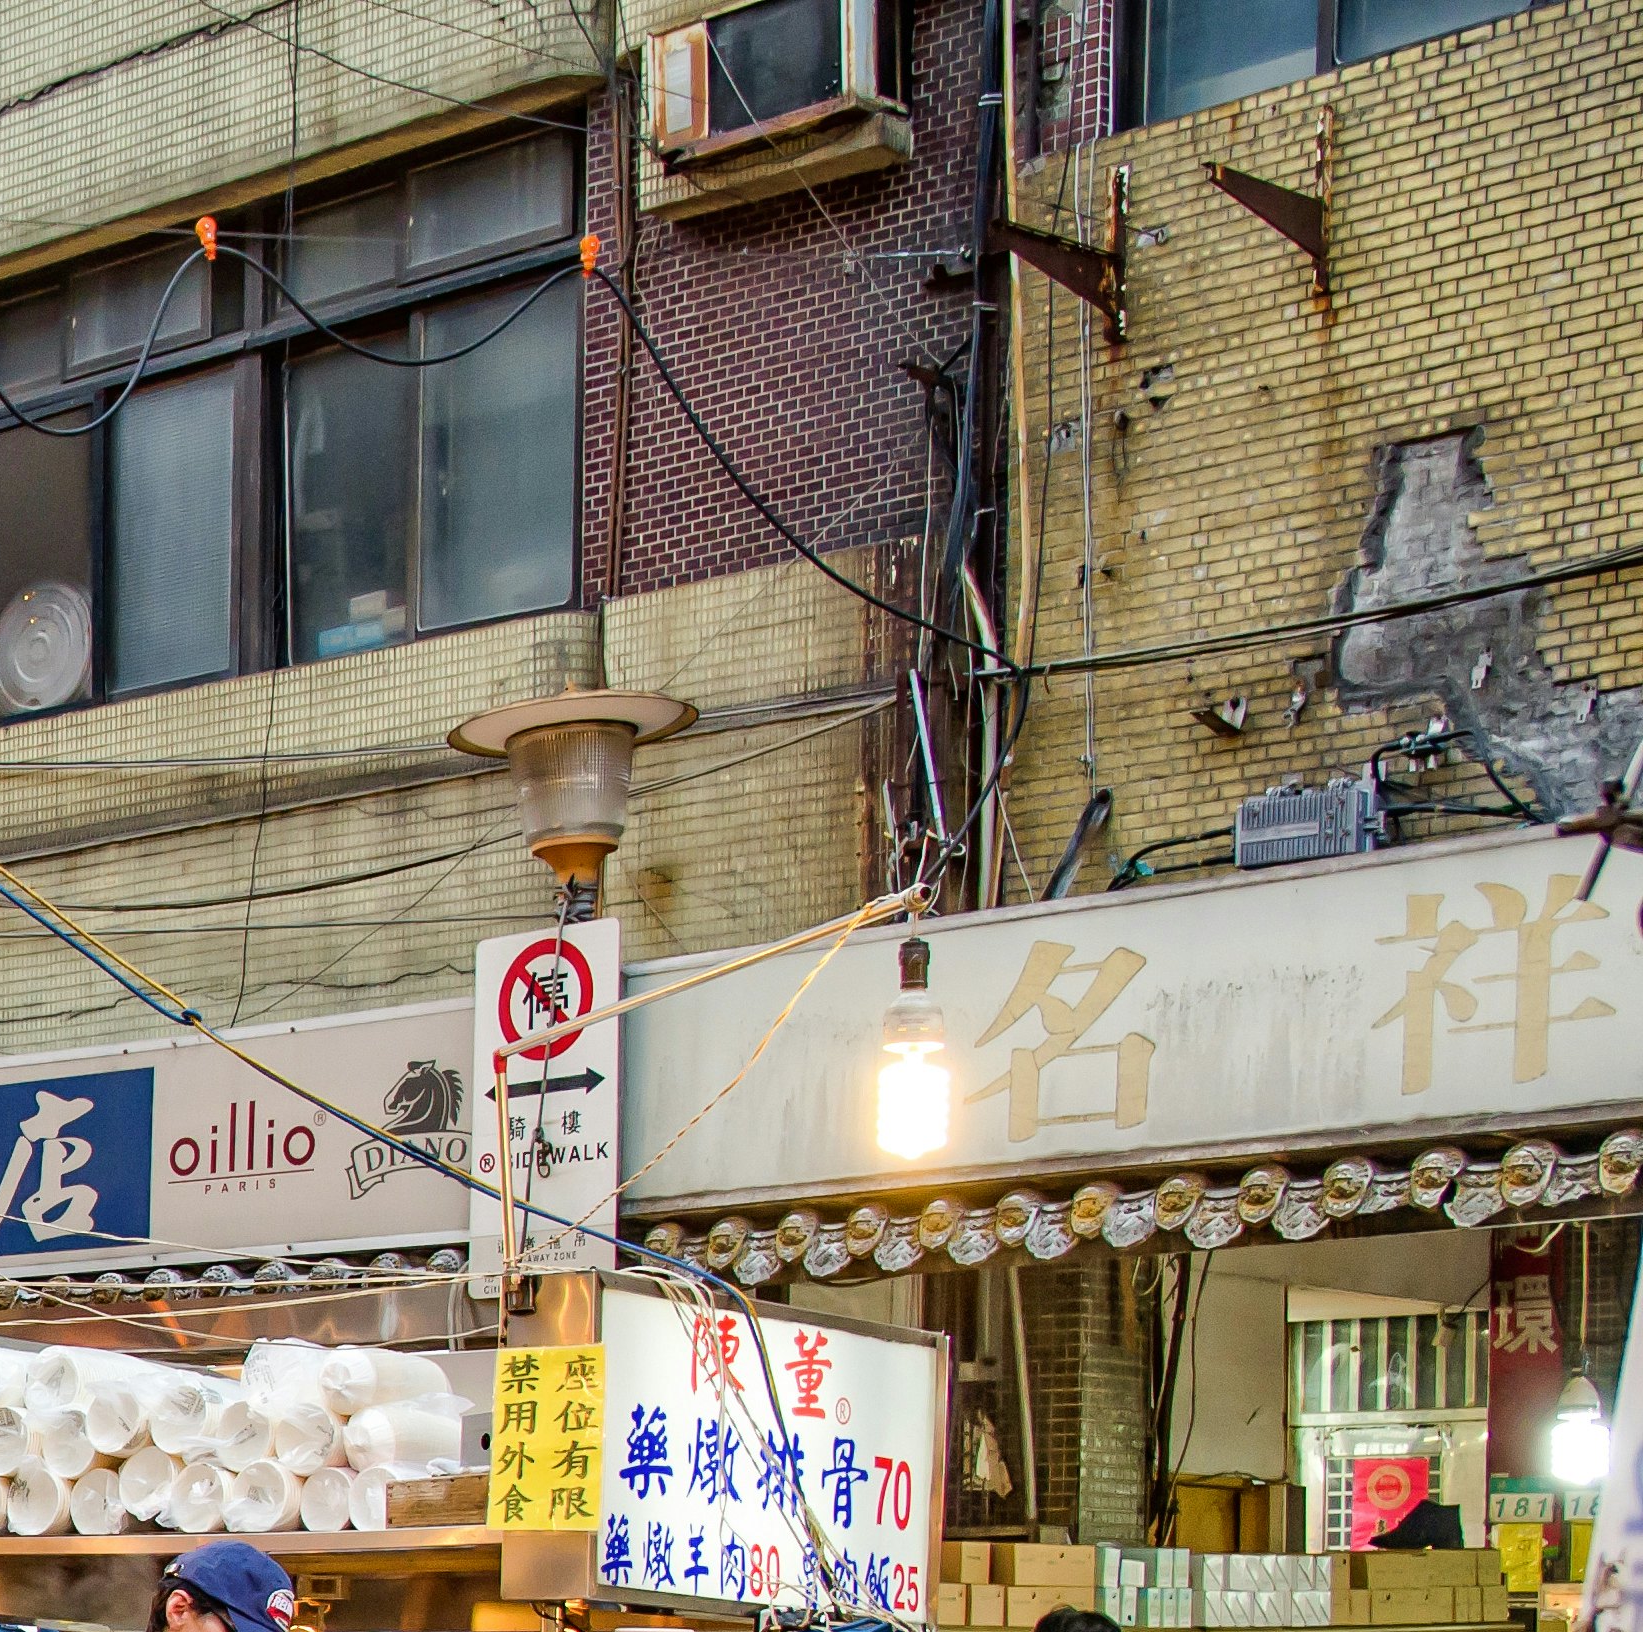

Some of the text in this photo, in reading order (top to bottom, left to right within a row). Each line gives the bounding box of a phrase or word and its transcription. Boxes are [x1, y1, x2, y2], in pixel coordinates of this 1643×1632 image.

[964, 874, 1618, 1143] 名祥
[169, 1101, 316, 1178] oillio
[204, 1178, 277, 1195] PARIS
[690, 1314, 833, 1420] 陳董
[494, 1355, 540, 1524] 禁用外食
[549, 1353, 599, 1520] 座位有限
[619, 1403, 912, 1532] 藥燉排骨 70
[1495, 1497, 1548, 1517] 181
[601, 1513, 745, 1596] 藥燉羊肉
[750, 1544, 781, 1597] 80
[893, 1565, 919, 1614] 25
